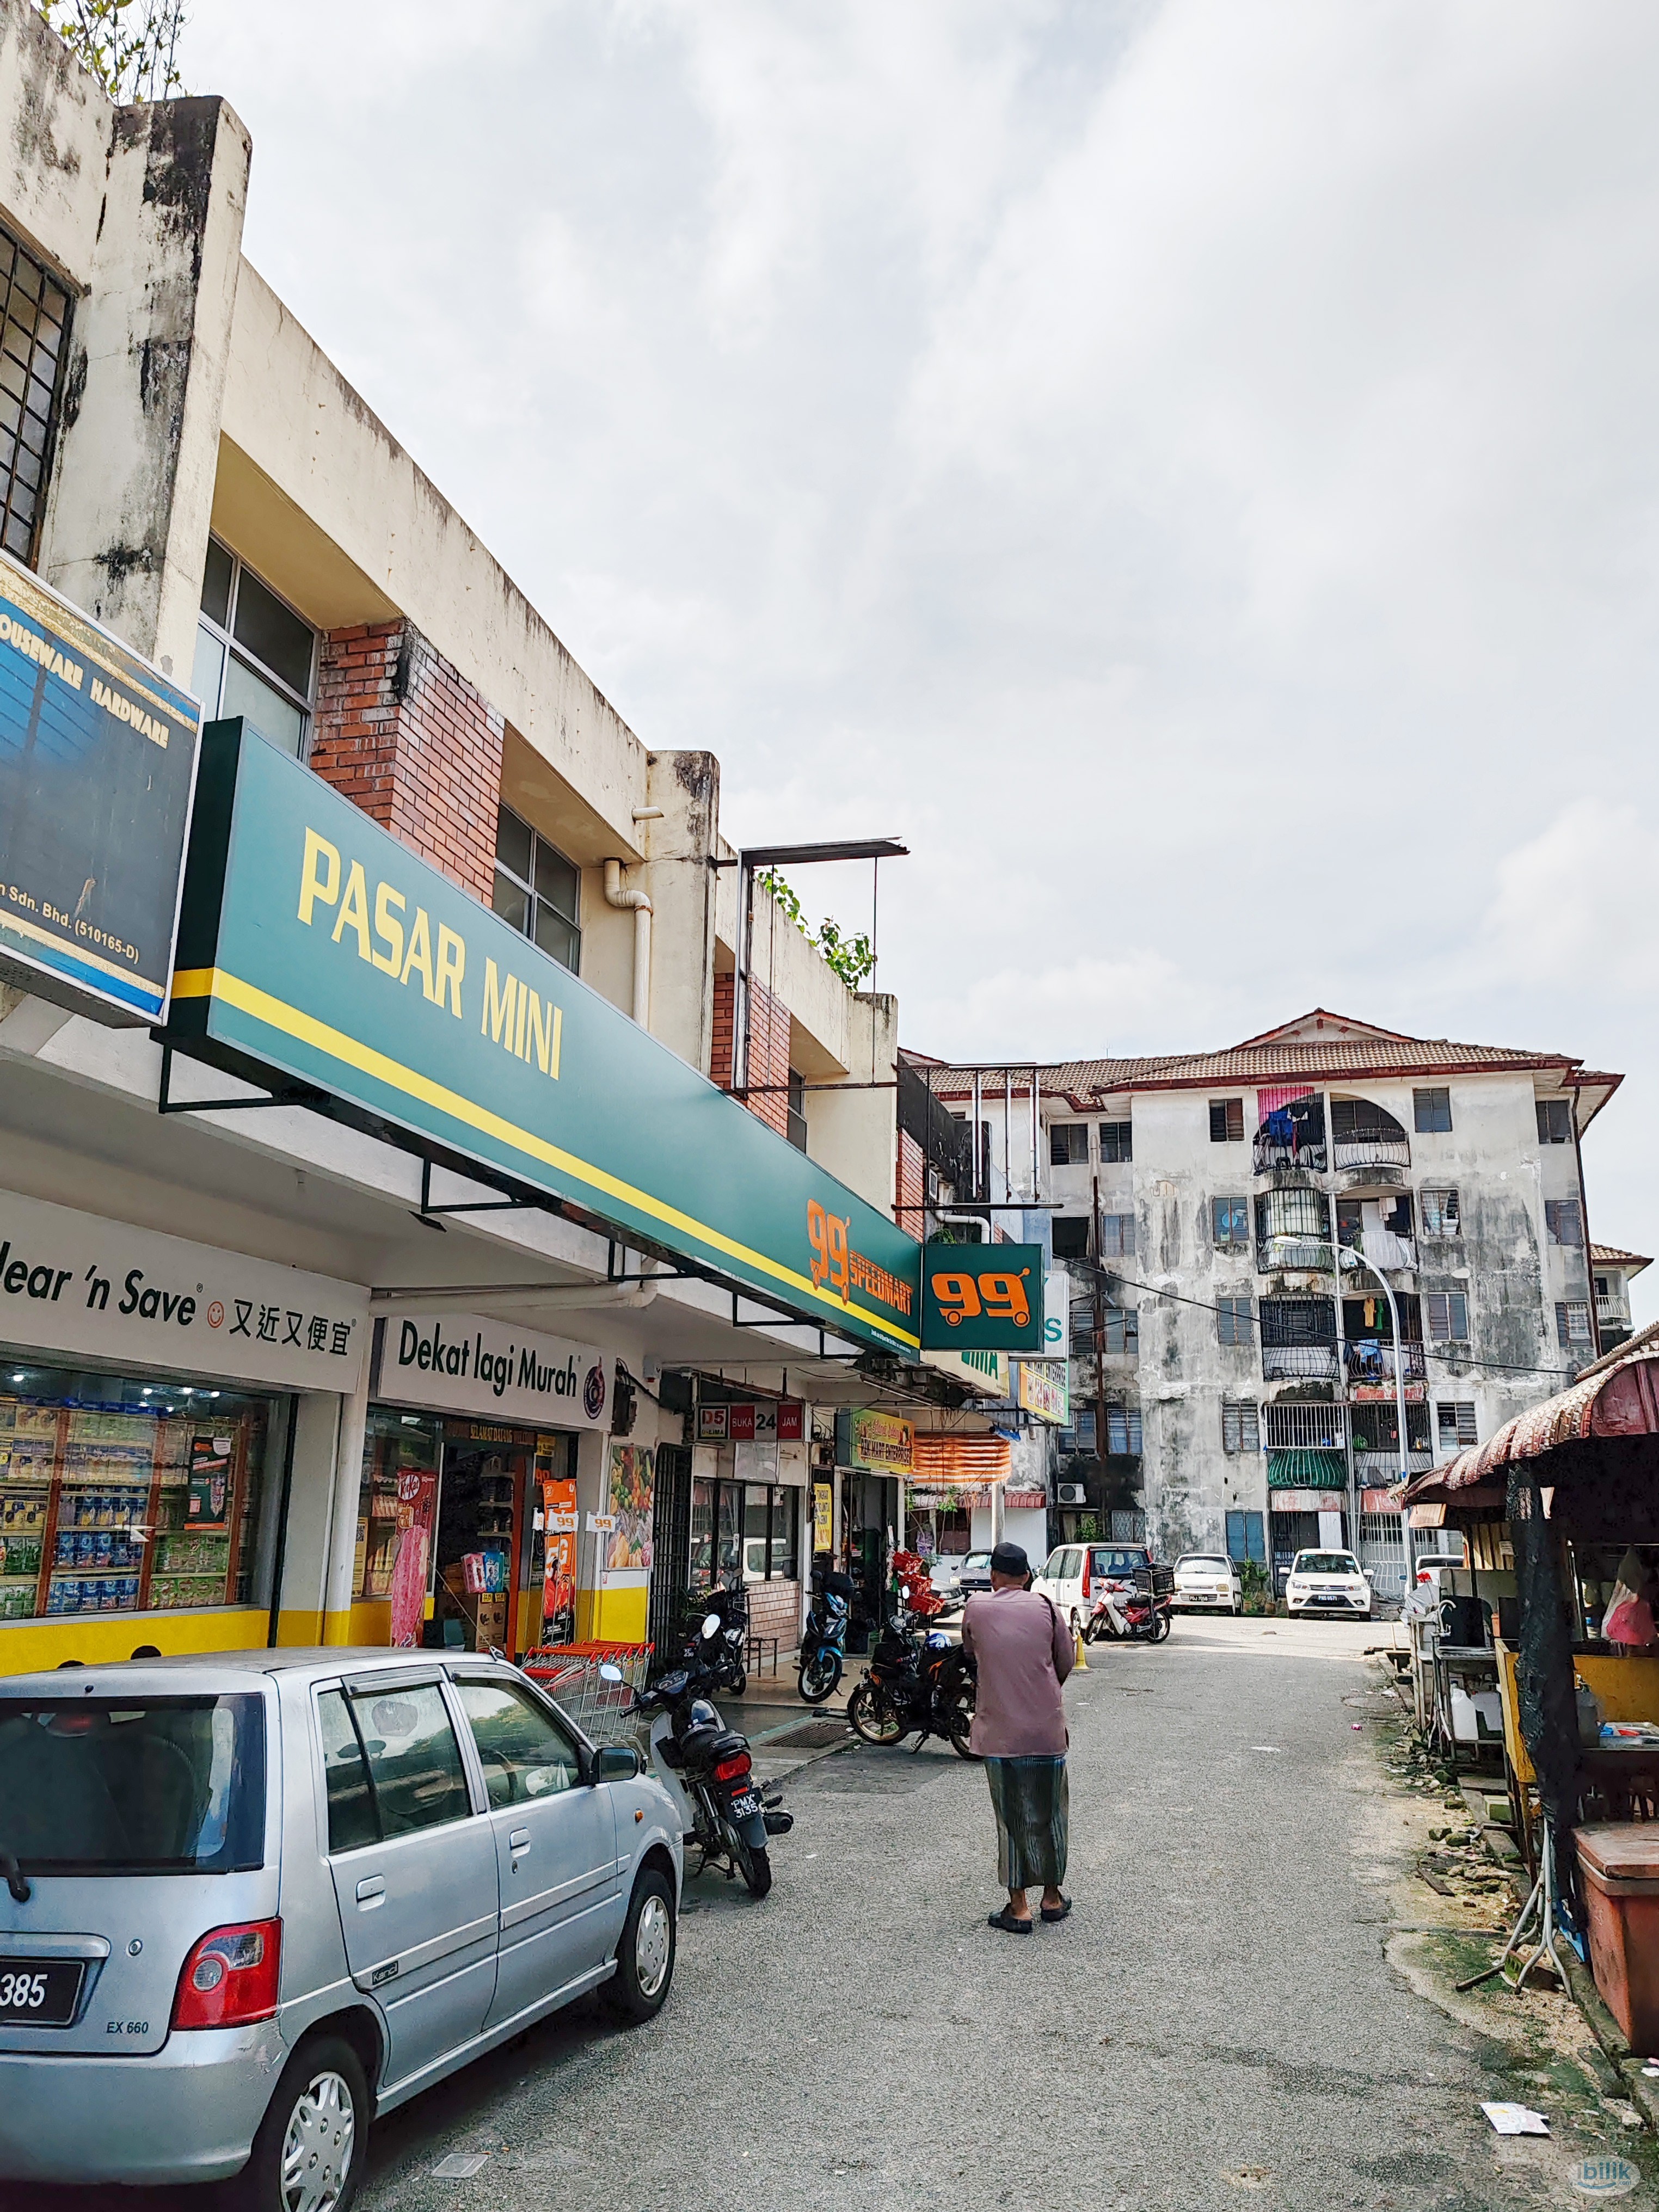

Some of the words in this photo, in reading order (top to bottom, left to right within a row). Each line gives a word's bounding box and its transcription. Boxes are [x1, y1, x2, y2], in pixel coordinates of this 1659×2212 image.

[90, 677, 169, 749] HARDWARE
[9, 886, 39, 913] Sdn.
[42, 902, 72, 929] Bhd.
[75, 919, 139, 964] (510165-D)
[297, 826, 465, 1019] PASAR
[481, 956, 563, 1081] MINI
[807, 1199, 851, 1305] 99
[850, 1250, 913, 1317] SPEEDMART
[932, 1268, 1031, 1327] 99
[229, 1299, 351, 1356] 又近又便宜
[399, 1320, 469, 1377] Dekat
[474, 1332, 514, 1397] lagi
[517, 1347, 576, 1398] Murah
[702, 1410, 724, 1424] D5
[732, 1417, 752, 1427] BUKA
[755, 1414, 776, 1430] 24
[782, 1416, 797, 1427] JAM
[557, 1517, 574, 1528] 99
[595, 1519, 612, 1529] 99
[733, 1794, 755, 1809] PMX
[734, 1802, 758, 1818] 3135
[0, 1974, 48, 2007] 385
[106, 2021, 123, 2033] EX
[127, 2021, 149, 2033] 660
